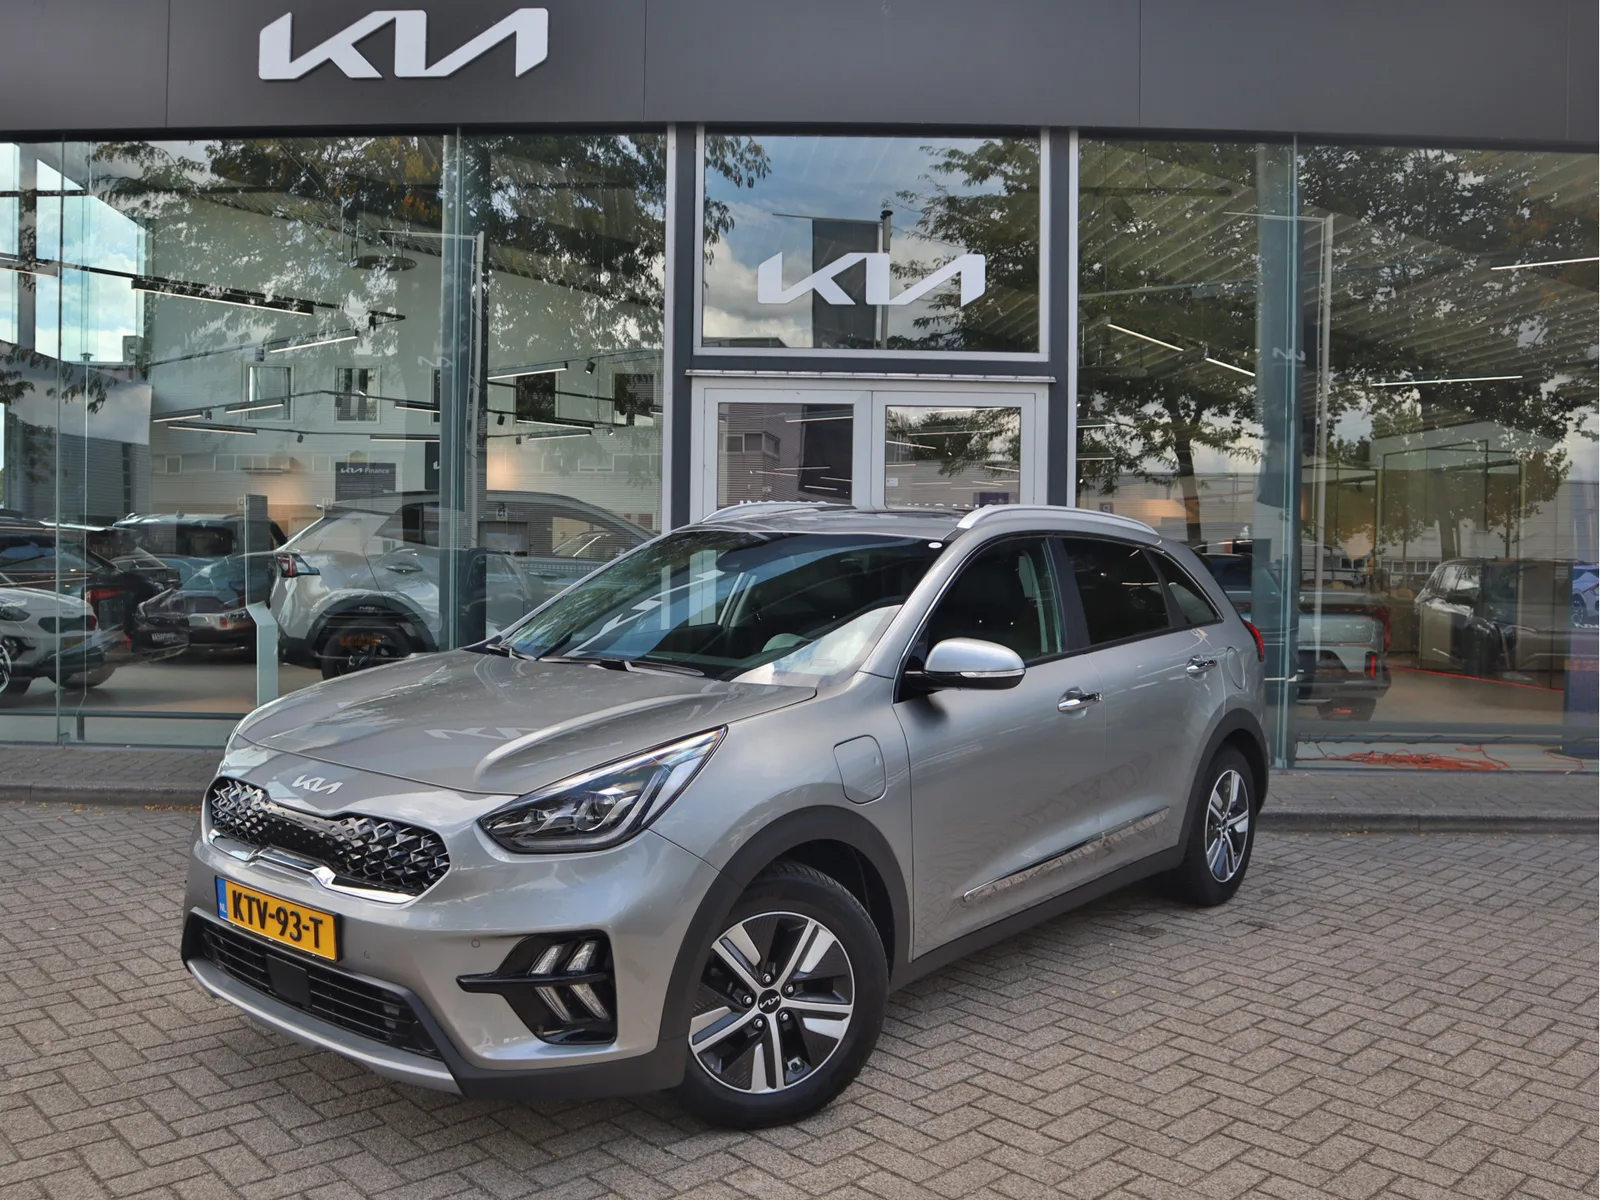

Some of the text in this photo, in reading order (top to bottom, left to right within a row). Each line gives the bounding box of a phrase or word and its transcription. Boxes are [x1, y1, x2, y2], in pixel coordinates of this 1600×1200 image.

[258, 7, 549, 80] KIA
[757, 251, 986, 307] KIA
[291, 774, 344, 795] KIA
[219, 901, 227, 913] NL
[231, 889, 323, 949] KTV-93-T
